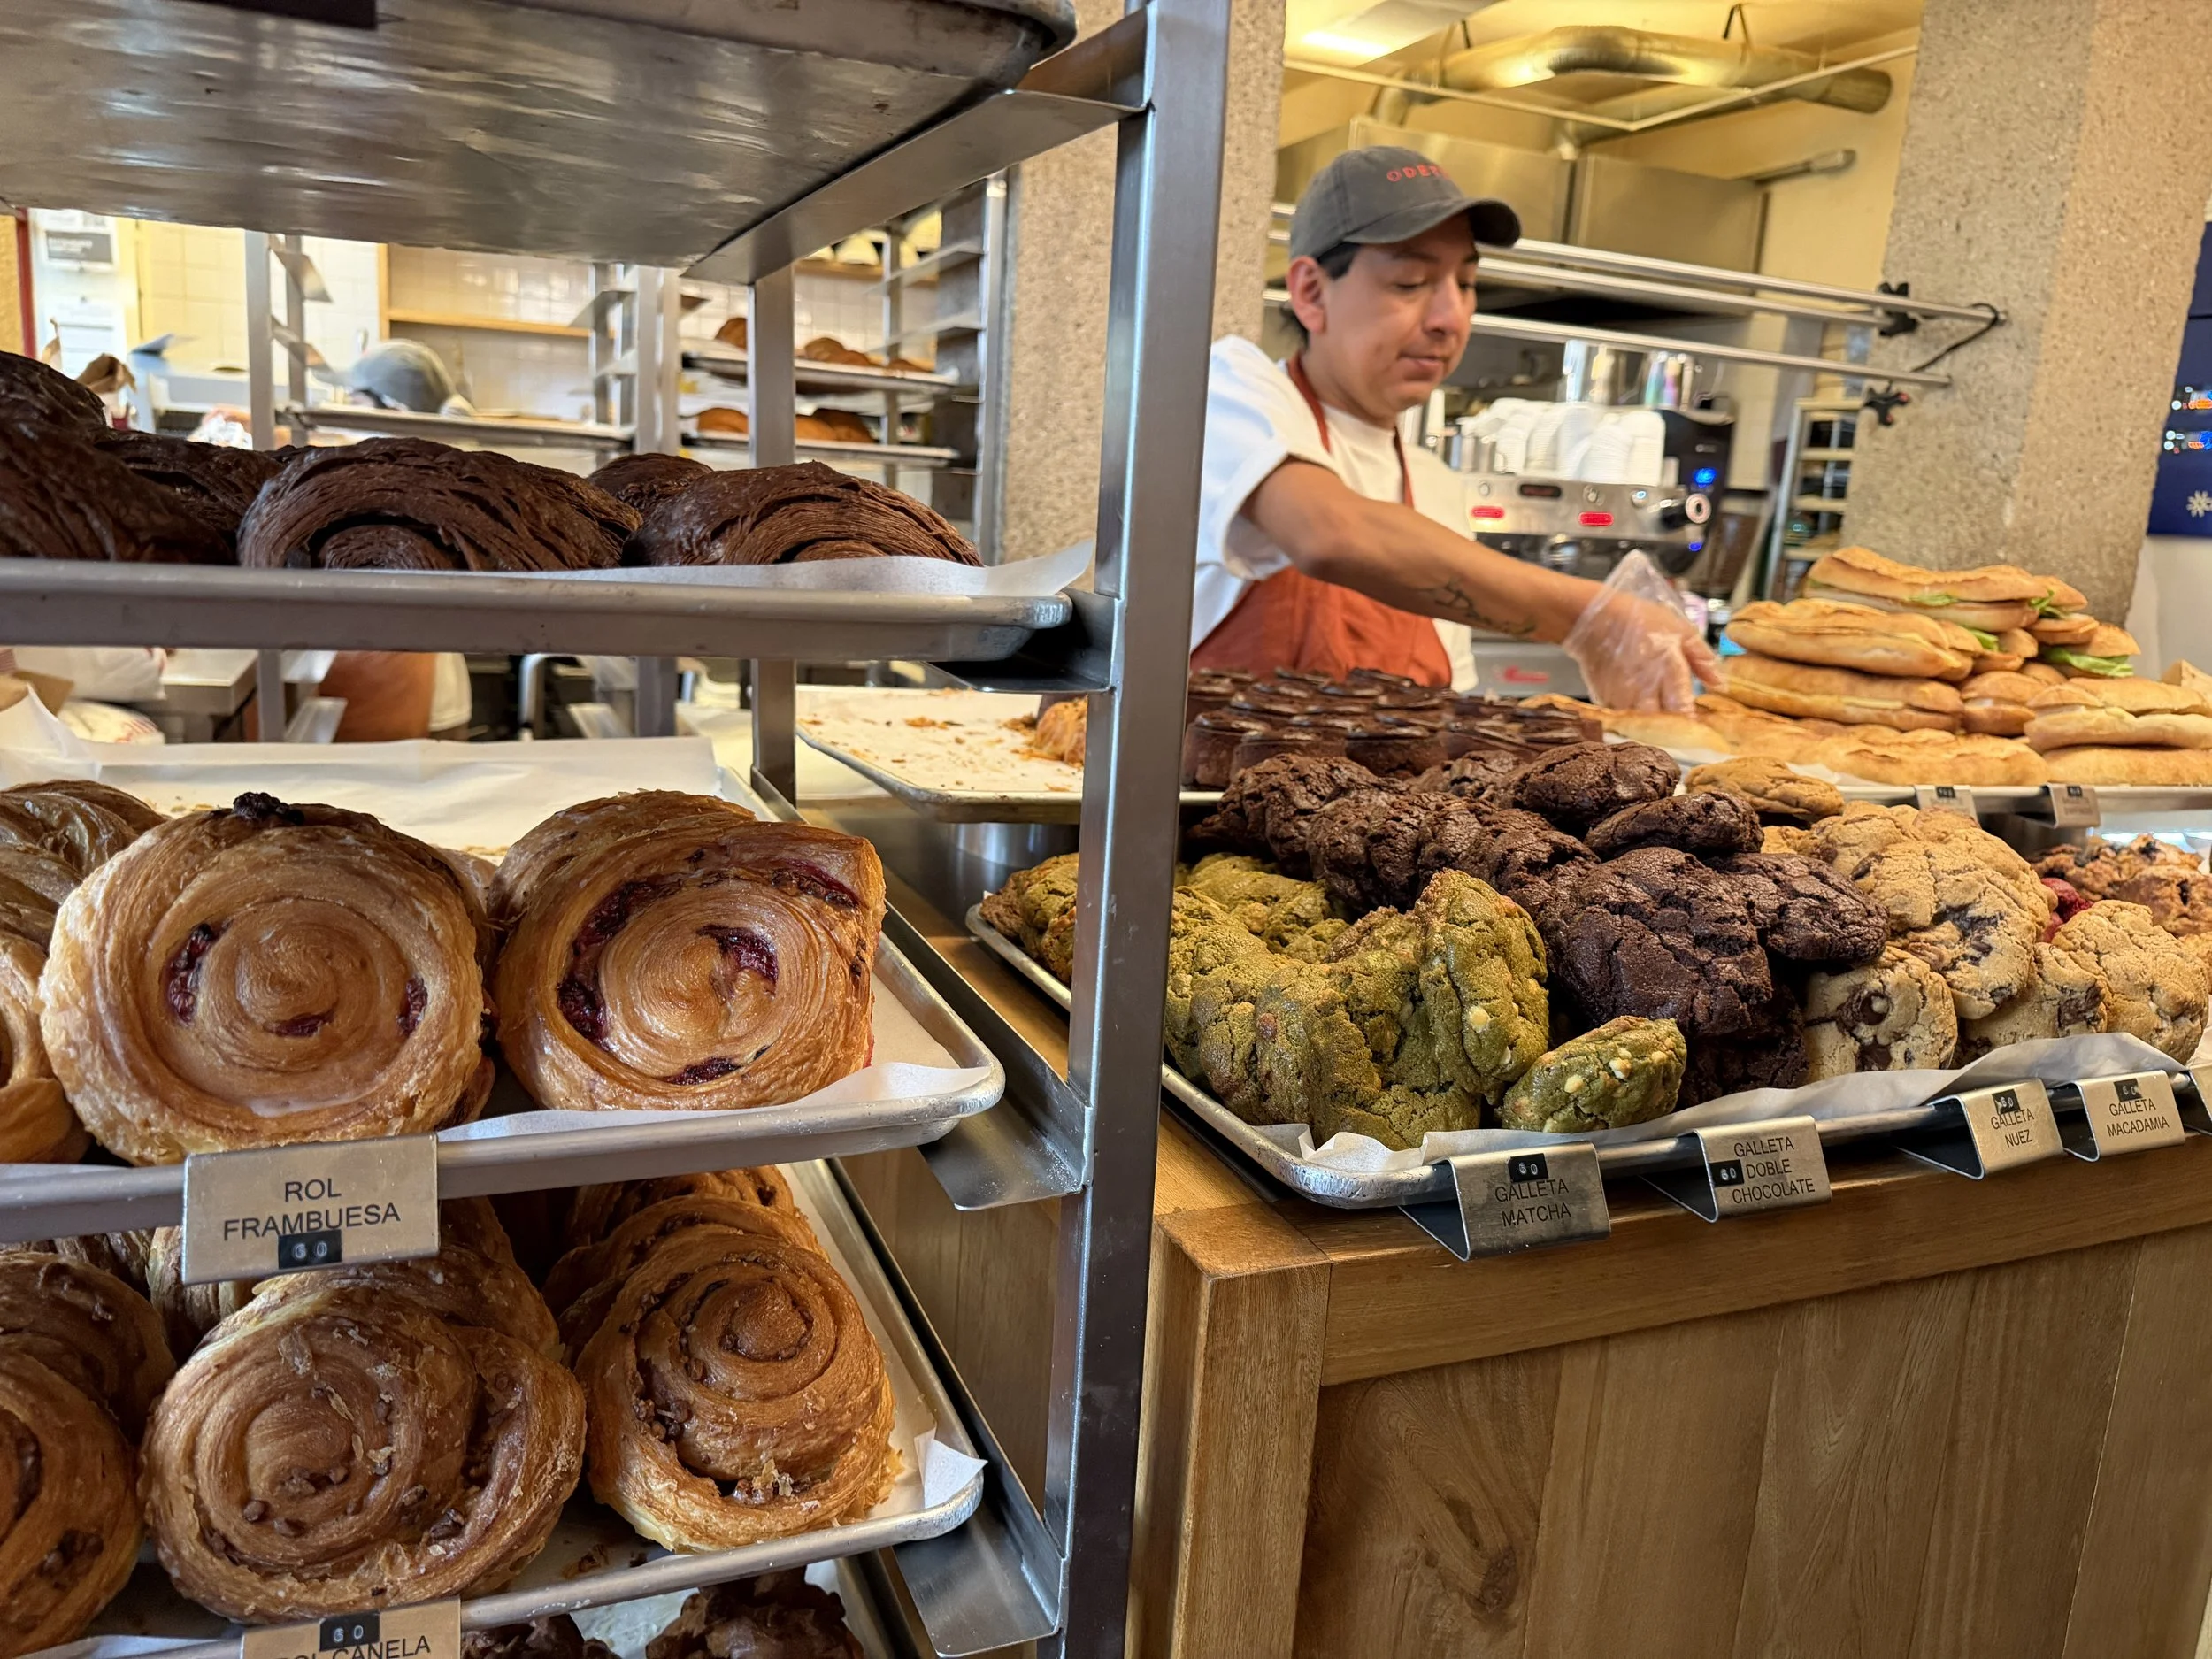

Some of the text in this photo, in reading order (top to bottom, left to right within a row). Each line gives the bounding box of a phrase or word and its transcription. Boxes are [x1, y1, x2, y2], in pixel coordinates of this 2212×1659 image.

[2108, 1098, 2156, 1117] GALLETA
[1991, 1108, 2034, 1130] GALLETA
[2107, 1116, 2170, 1138] MACADAMIA
[1734, 1136, 1795, 1157] GALLETA
[2005, 1129, 2033, 1148] NUEZ
[1518, 1162, 1539, 1175] 60
[1720, 1168, 1737, 1181] 60
[1746, 1159, 1793, 1179] DOBLE
[284, 1178, 342, 1202] ROL
[1494, 1178, 1570, 1202] GALLETA
[1732, 1178, 1816, 1204] CHOCOLATE
[223, 1202, 401, 1240] FRAMBUESA
[1502, 1202, 1572, 1227] MATCHA
[292, 1241, 328, 1260] 60
